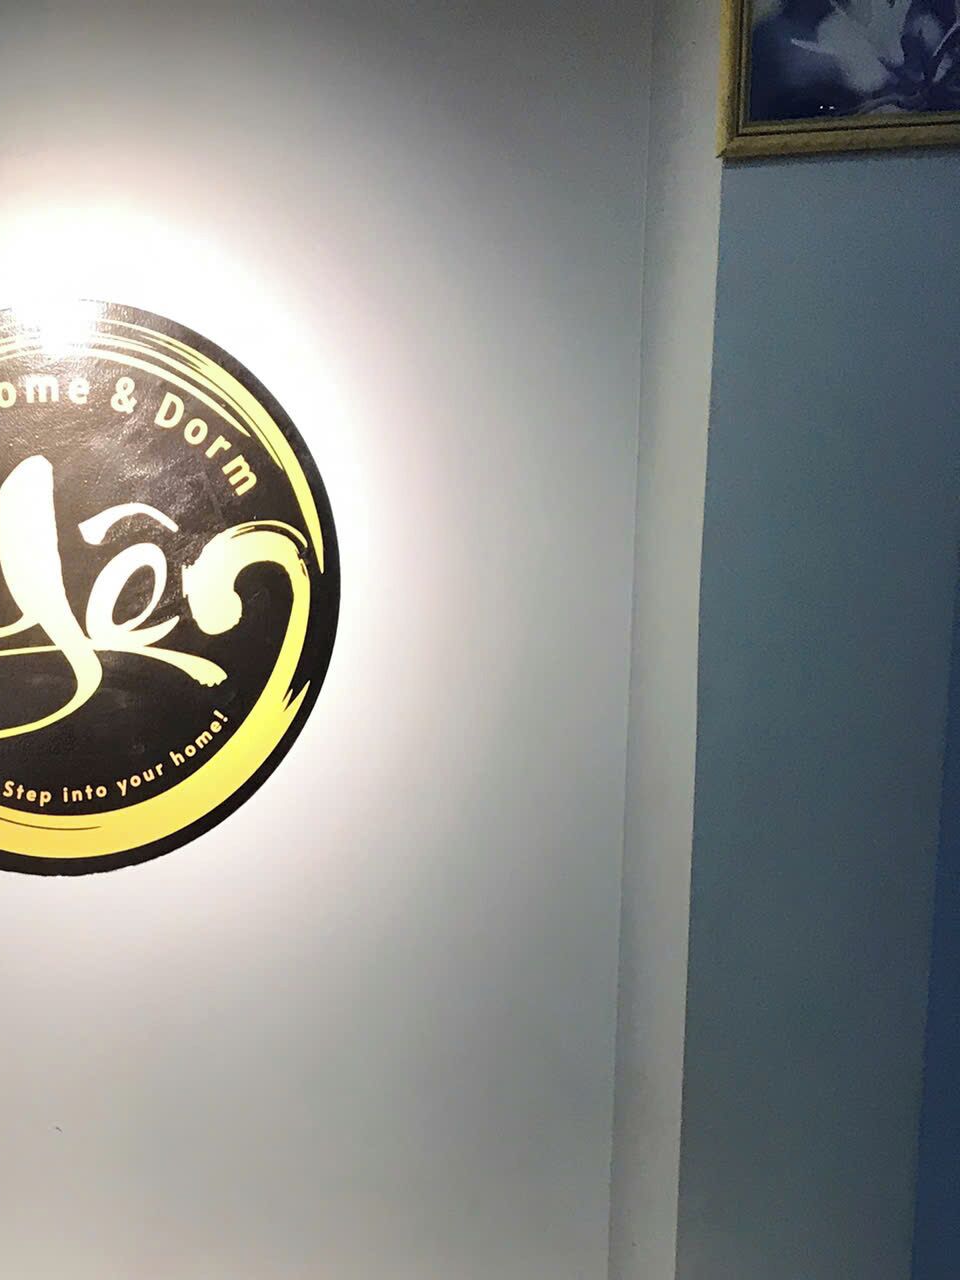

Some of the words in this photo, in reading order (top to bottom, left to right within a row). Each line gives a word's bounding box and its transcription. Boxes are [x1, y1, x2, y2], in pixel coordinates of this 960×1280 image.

[110, 377, 138, 414] &
[154, 391, 257, 496] Dorm
[2, 780, 52, 807] Step
[63, 785, 107, 802] into
[116, 763, 164, 796] your
[169, 709, 228, 766] home!
